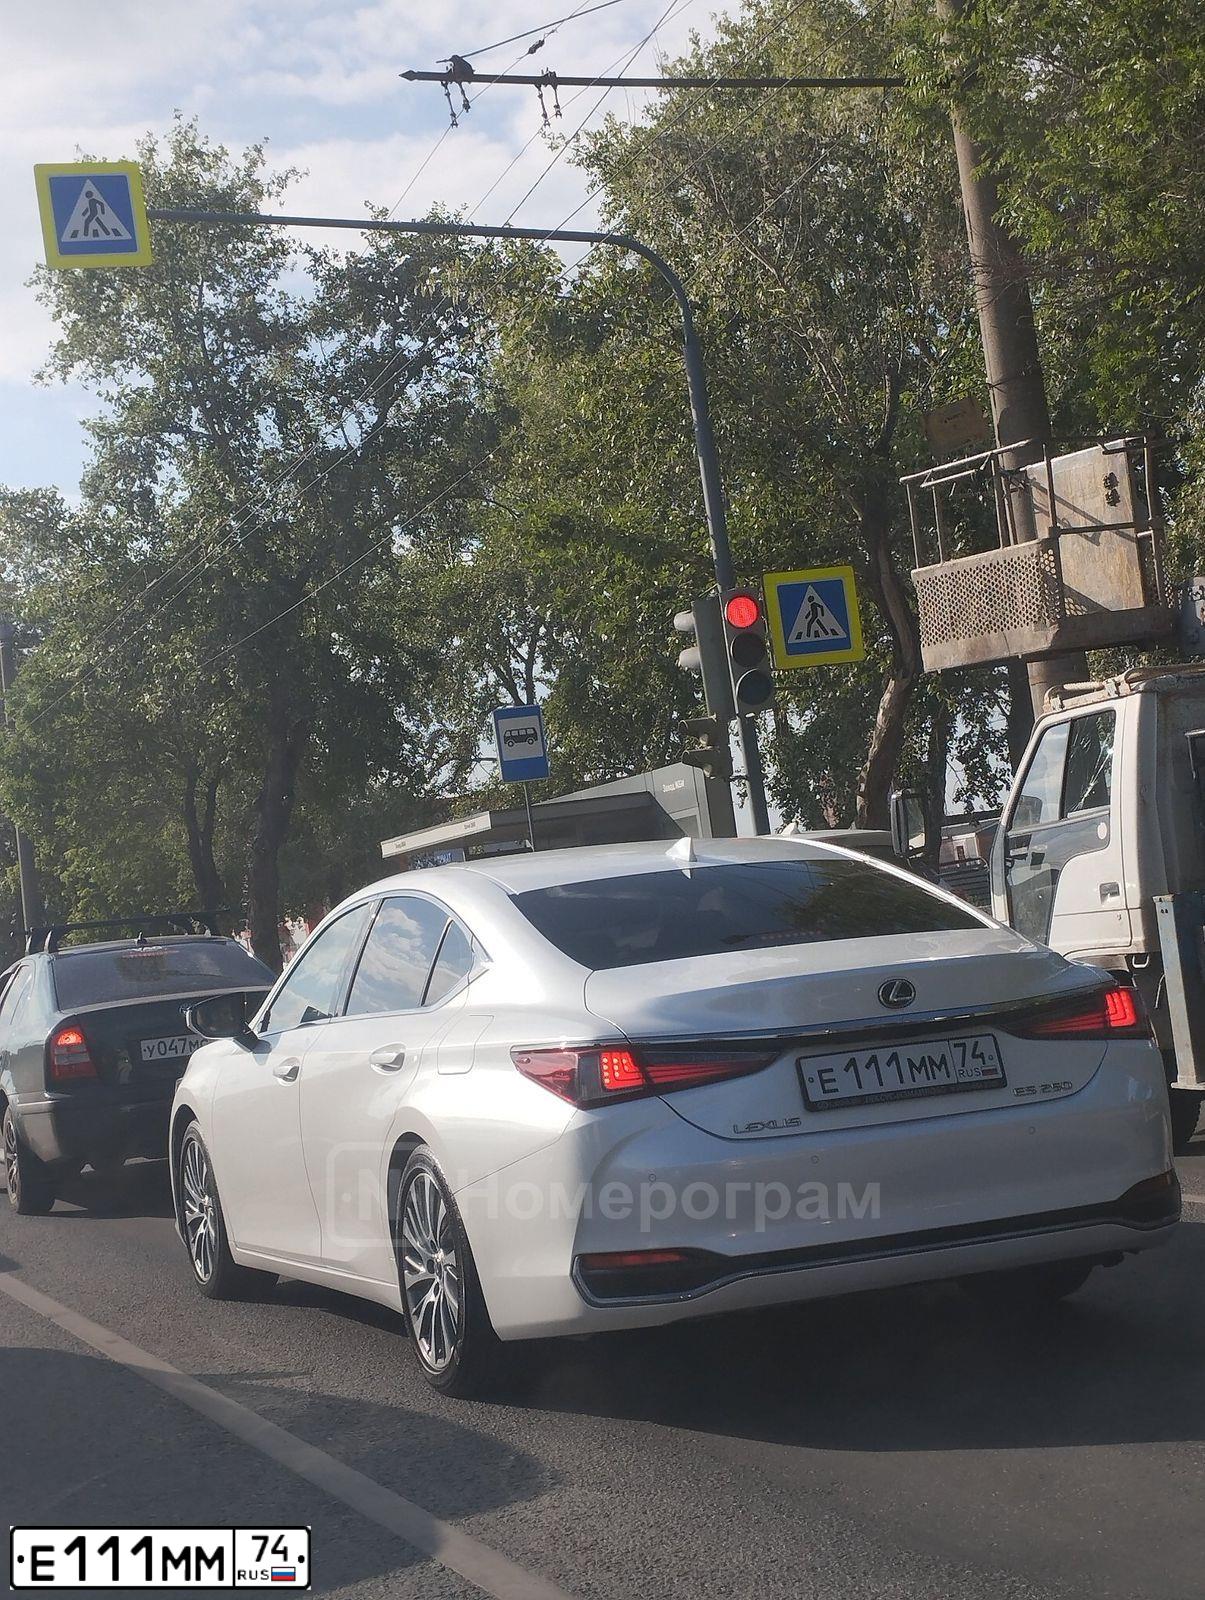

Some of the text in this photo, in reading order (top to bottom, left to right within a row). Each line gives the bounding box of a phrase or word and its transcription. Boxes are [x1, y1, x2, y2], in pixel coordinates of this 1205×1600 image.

[817, 1041, 986, 1094] Е111ММ 74
[958, 1067, 982, 1078] RUS
[1013, 1081, 1072, 1097] ES 250
[733, 1117, 801, 1134] LEXUS
